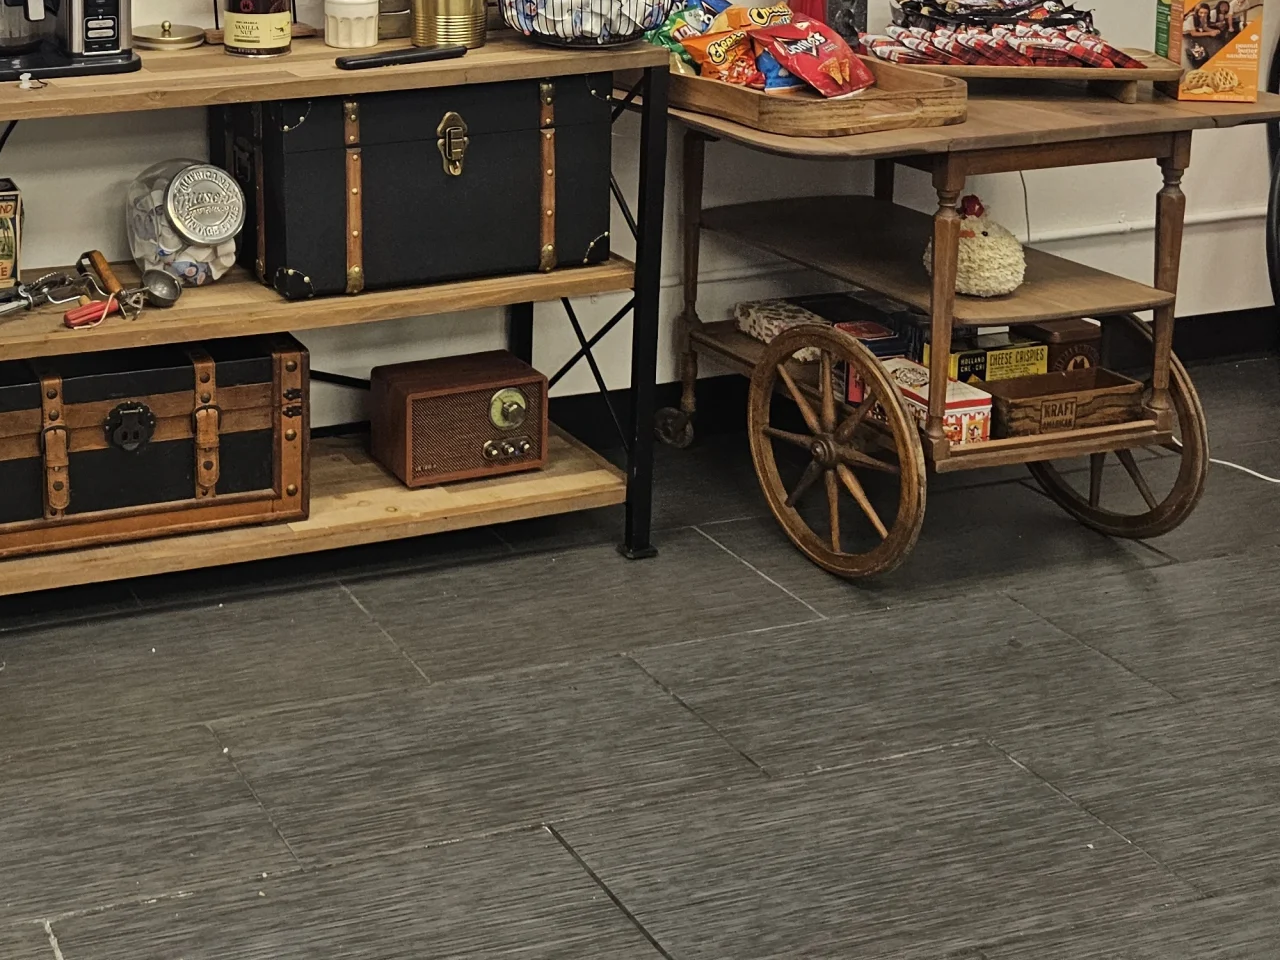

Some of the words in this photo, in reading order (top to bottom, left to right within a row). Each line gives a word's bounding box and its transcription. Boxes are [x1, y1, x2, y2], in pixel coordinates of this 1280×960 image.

[960, 356, 985, 366] HOLLAND
[990, 352, 1012, 366] CHEESE
[1016, 348, 1044, 364] CRISPIES
[1044, 402, 1075, 418] KRAFT
